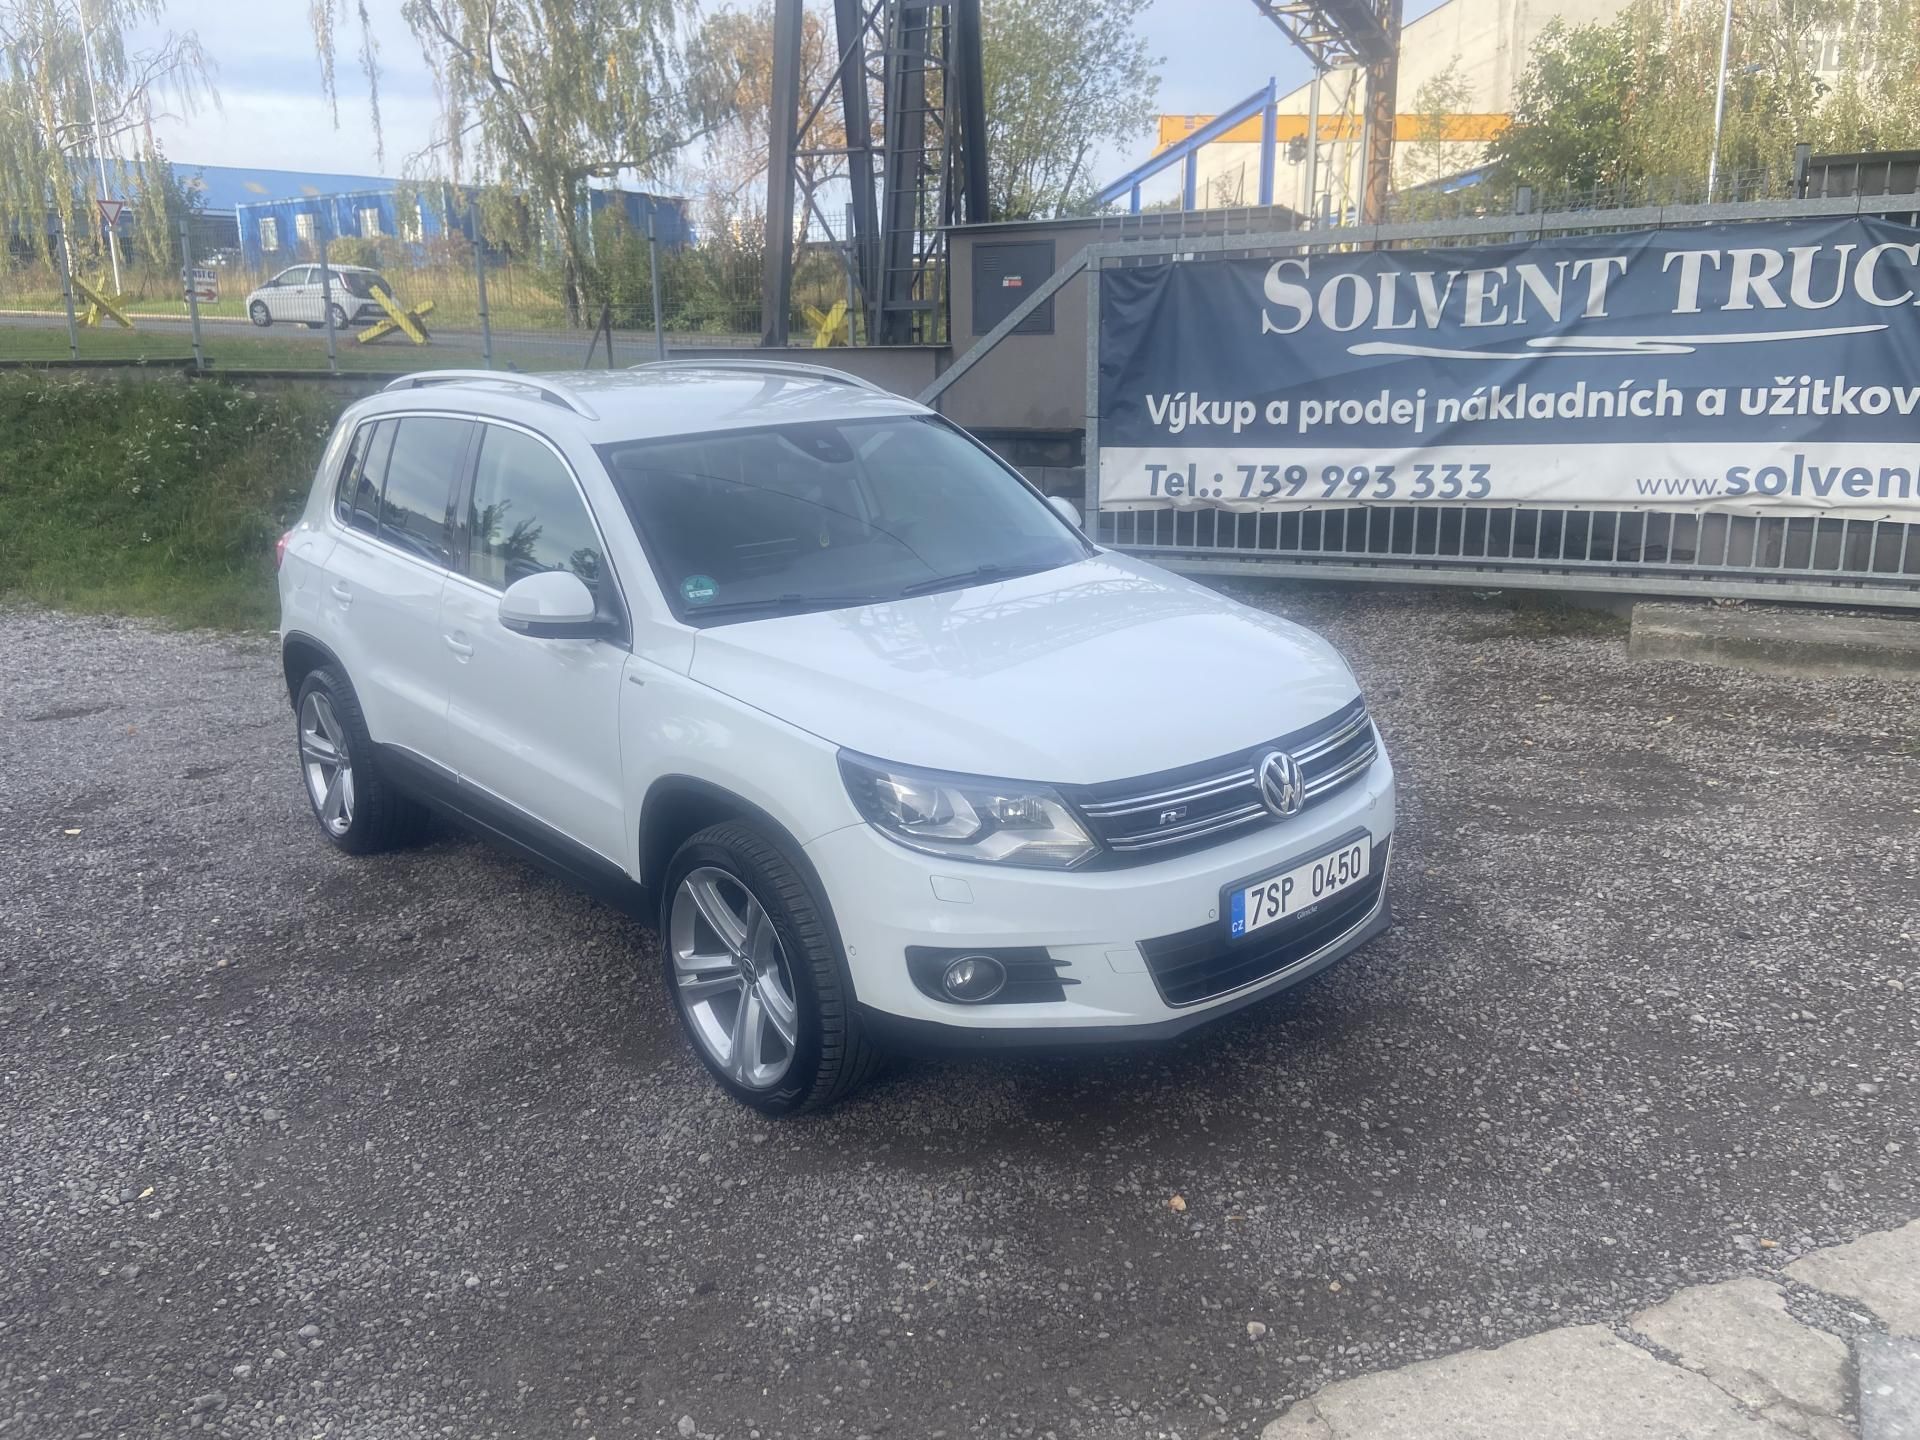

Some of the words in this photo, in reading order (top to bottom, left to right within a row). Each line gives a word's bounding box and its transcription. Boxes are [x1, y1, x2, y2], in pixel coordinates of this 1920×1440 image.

[1662, 242, 1920, 314] TRUC
[1145, 392, 1257, 434] Výkup
[1265, 398, 1289, 425] a
[1299, 388, 1427, 433] prodej
[1436, 379, 1684, 423] nákladních
[1696, 388, 1727, 416] a
[1740, 375, 1920, 416] užitkov
[1145, 463, 1223, 498] Tel.:
[1237, 464, 1308, 498] 739
[1321, 464, 1397, 499] 993
[1410, 463, 1492, 499] 333
[1251, 876, 1294, 926] 7SP
[1312, 846, 1361, 897] 0450
[1232, 919, 1244, 933] CZ
